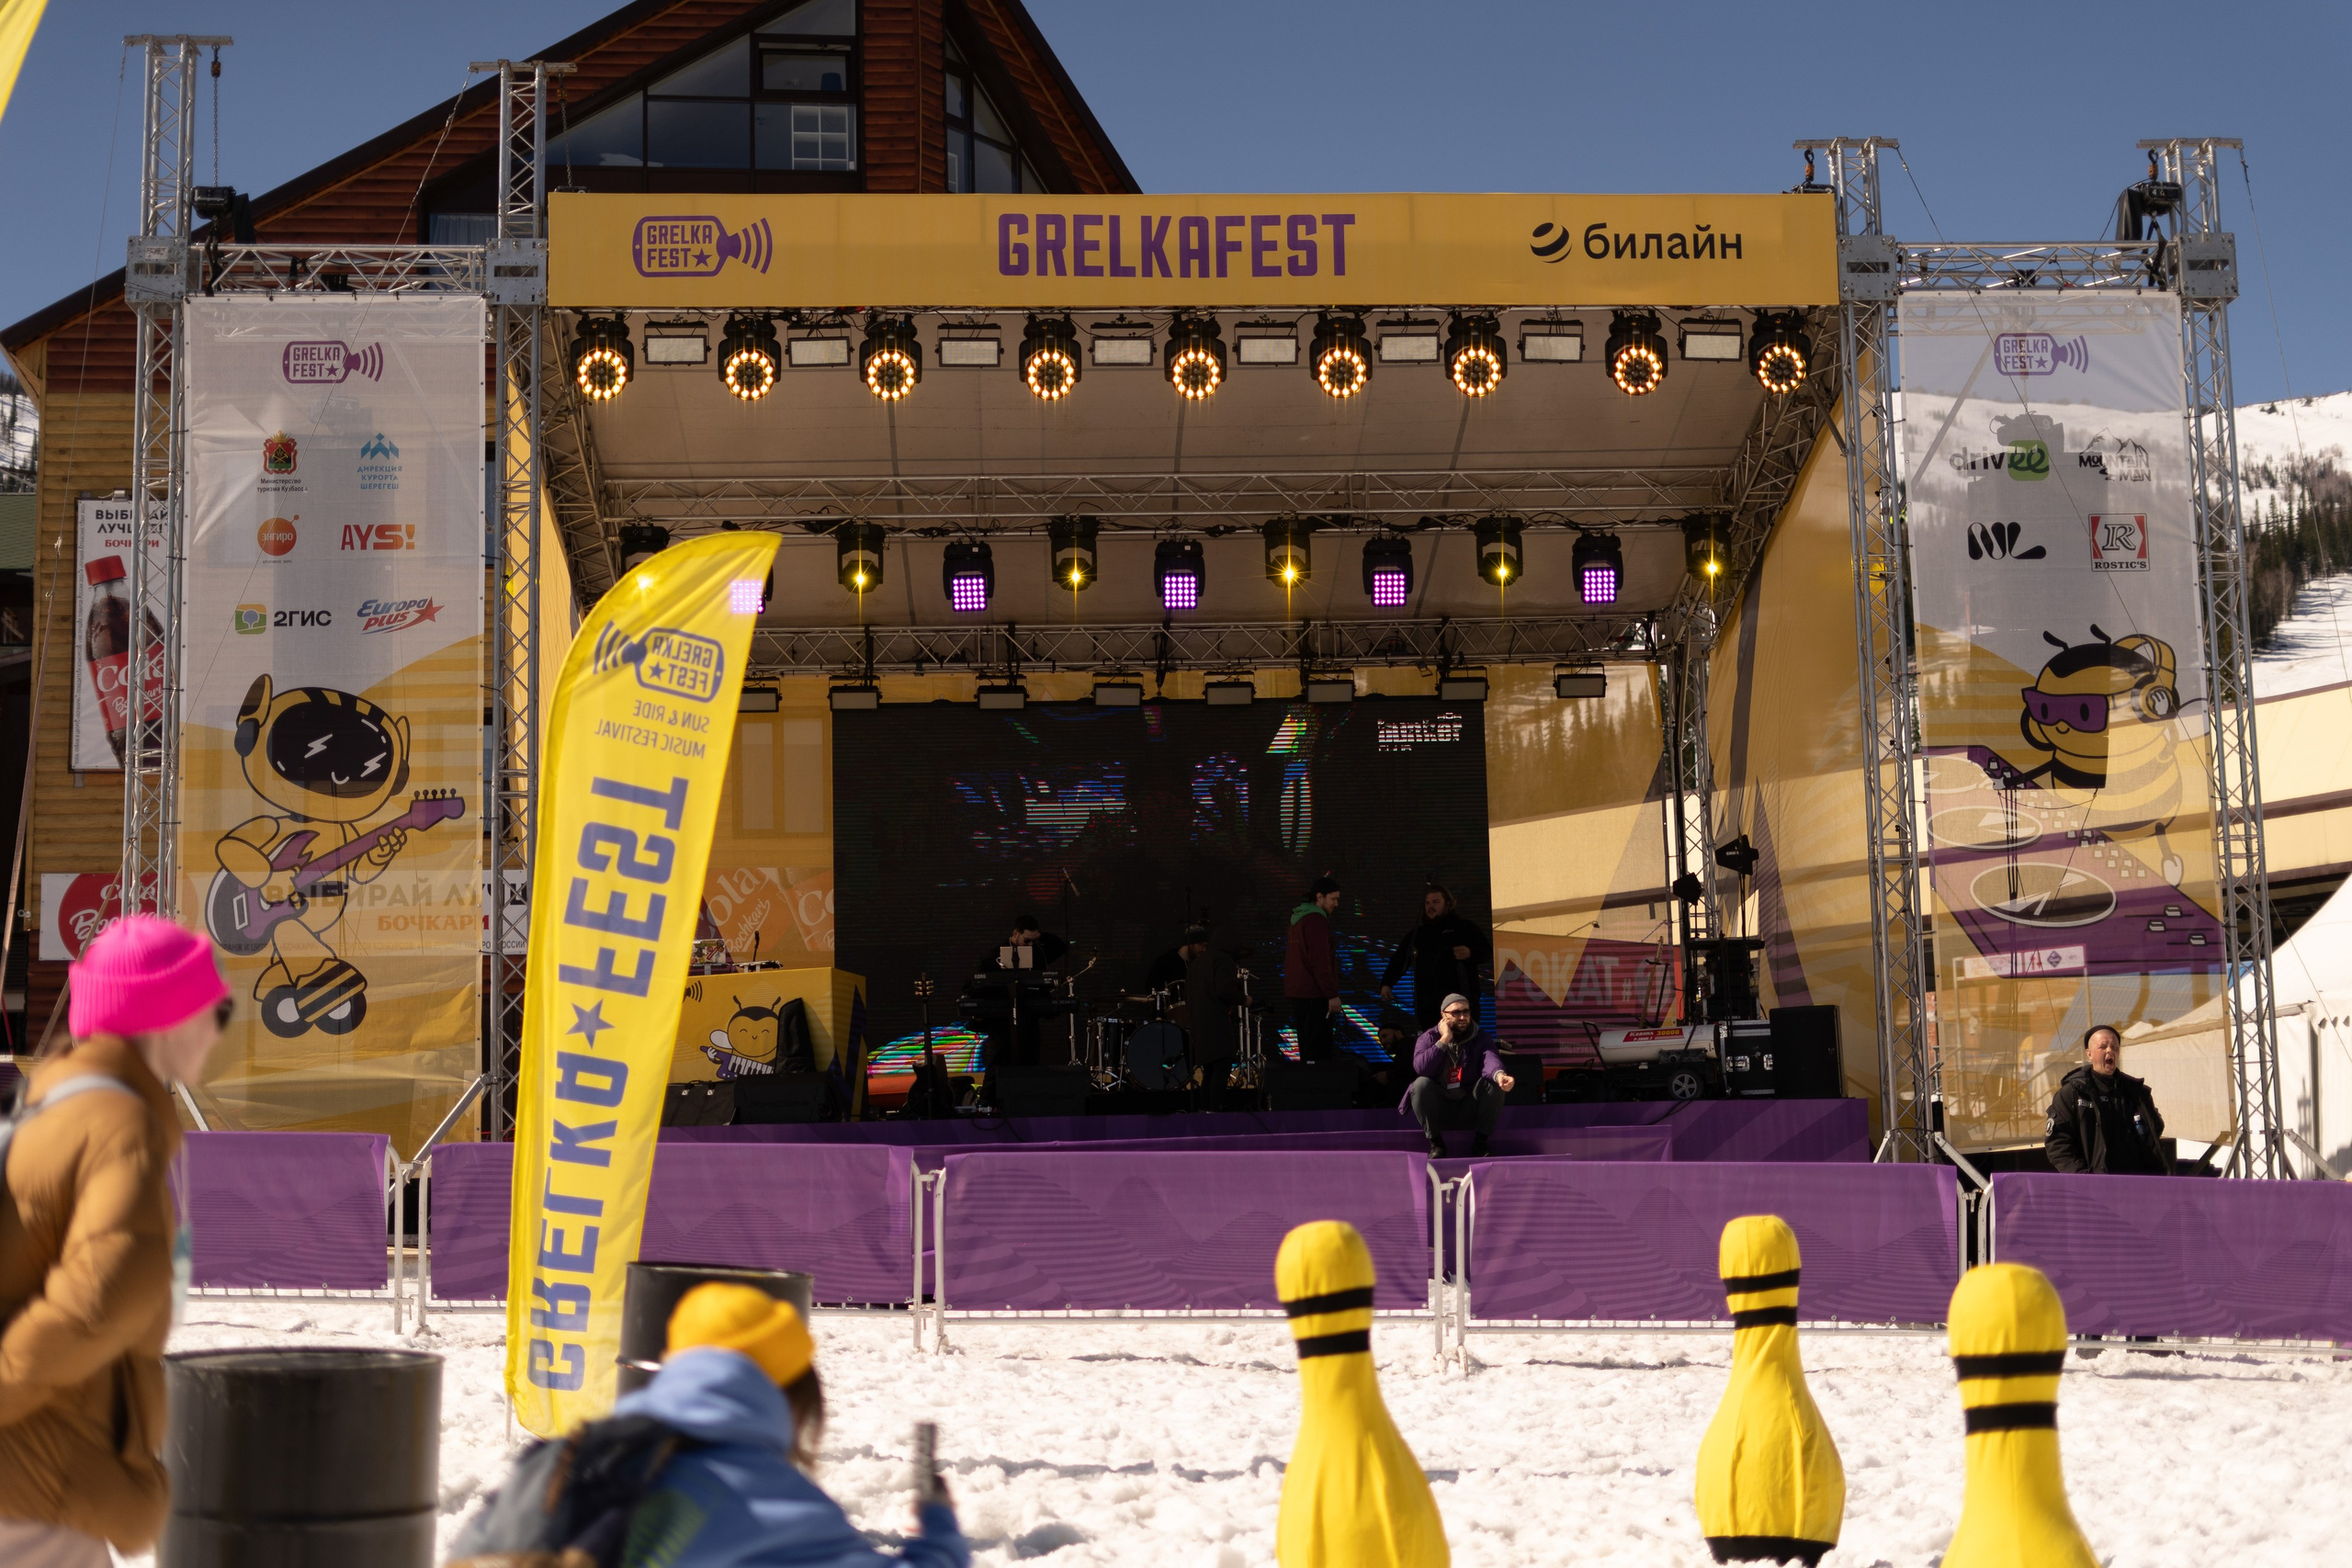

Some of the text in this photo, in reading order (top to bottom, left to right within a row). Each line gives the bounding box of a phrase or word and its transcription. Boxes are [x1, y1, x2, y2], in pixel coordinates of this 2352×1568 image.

[647, 224, 712, 244] GRELKA
[1583, 221, 1743, 260] билайн
[998, 212, 1356, 278] GRELKAFEST
[647, 247, 691, 268] FEST
[293, 346, 341, 361] GRELKA
[2003, 339, 2049, 354] GRELKA
[2004, 355, 2034, 369] FEST
[293, 363, 325, 378] FEST
[1949, 446, 2050, 474] drivee
[2078, 454, 2149, 469] MOUNTAIN
[2119, 468, 2152, 482] MAN
[262, 532, 294, 544] энгиро
[340, 524, 415, 551] AYS!
[2094, 560, 2147, 570] ROSTIC'S
[273, 610, 332, 626] 2ГИС
[378, 914, 490, 931] БОЧКАРИ
